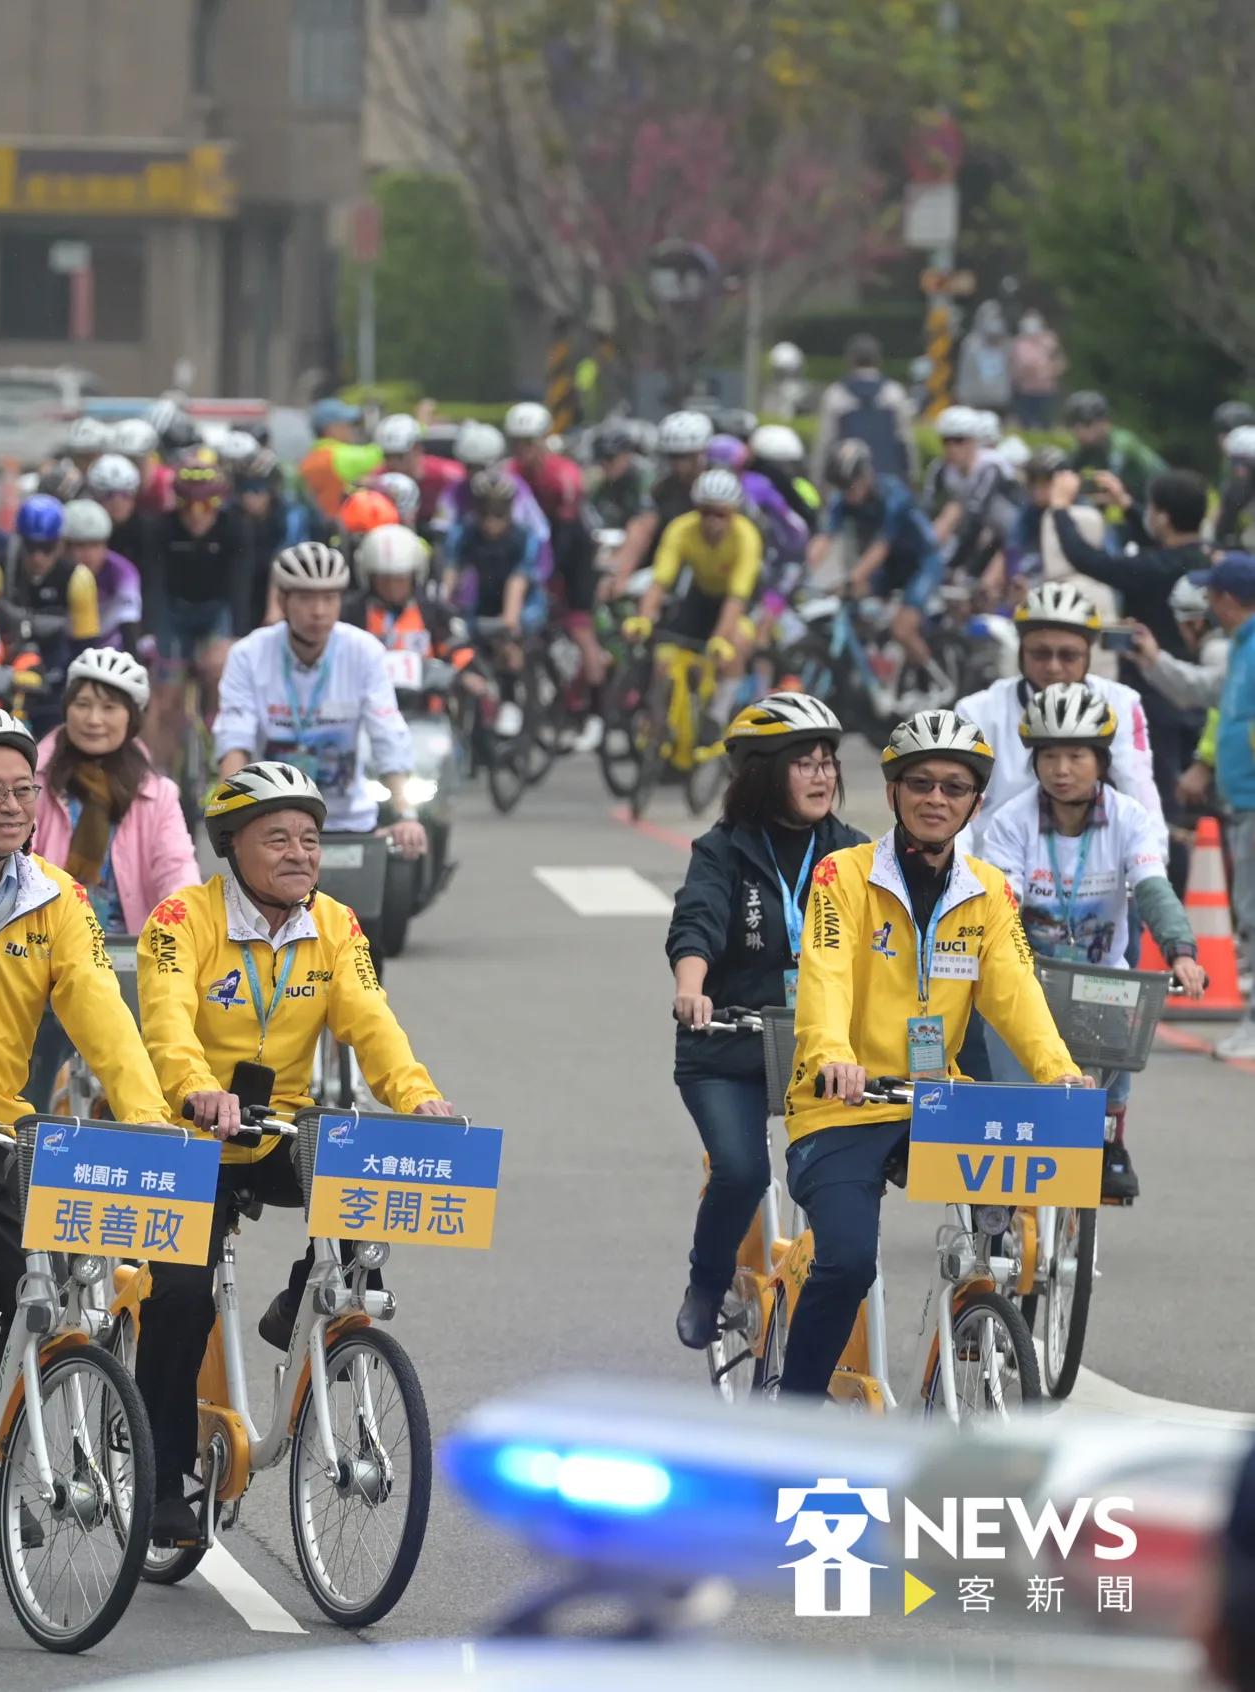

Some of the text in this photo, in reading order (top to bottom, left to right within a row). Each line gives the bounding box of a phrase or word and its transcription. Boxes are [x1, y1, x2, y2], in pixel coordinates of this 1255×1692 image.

[746, 889, 765, 951] 王芳琳
[813, 891, 822, 949] EXCELLENCE
[823, 891, 840, 949] AIWAN
[957, 926, 985, 937] 202
[941, 941, 967, 952] UCI
[291, 986, 315, 998] UCI
[983, 1121, 1035, 1142] 貴賓
[73, 1163, 176, 1193] 桃園市 市長
[362, 1153, 453, 1180] 大會執行長
[956, 1153, 1058, 1194] VIP
[53, 1199, 185, 1254] 張善政
[339, 1186, 467, 1236] 李開志
